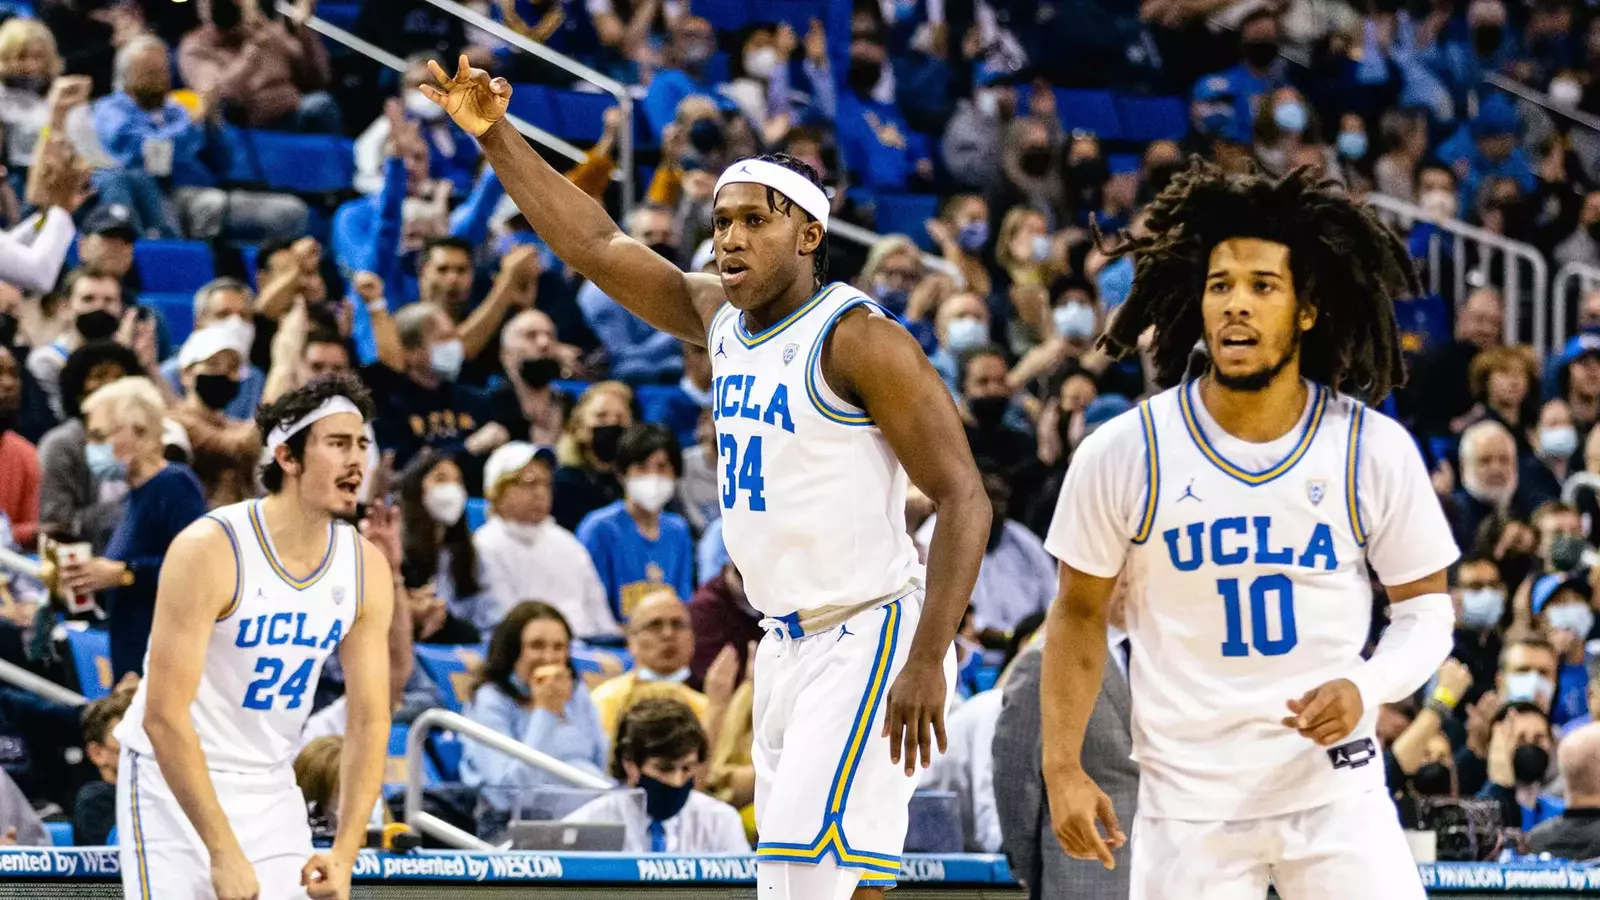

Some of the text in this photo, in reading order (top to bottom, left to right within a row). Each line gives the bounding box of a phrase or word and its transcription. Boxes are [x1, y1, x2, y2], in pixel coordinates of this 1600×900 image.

[711, 374, 796, 434] UCLA
[719, 432, 767, 512] 34
[1162, 516, 1339, 572] UCLA
[235, 612, 342, 650] UCLA
[1216, 573, 1298, 657] 10
[241, 657, 316, 710] 24
[0, 851, 51, 872] ented
[53, 850, 78, 876] by
[384, 854, 465, 879] presented
[464, 855, 489, 882] by
[636, 858, 697, 880] PAULEY
[1437, 865, 1504, 888] PAVILION
